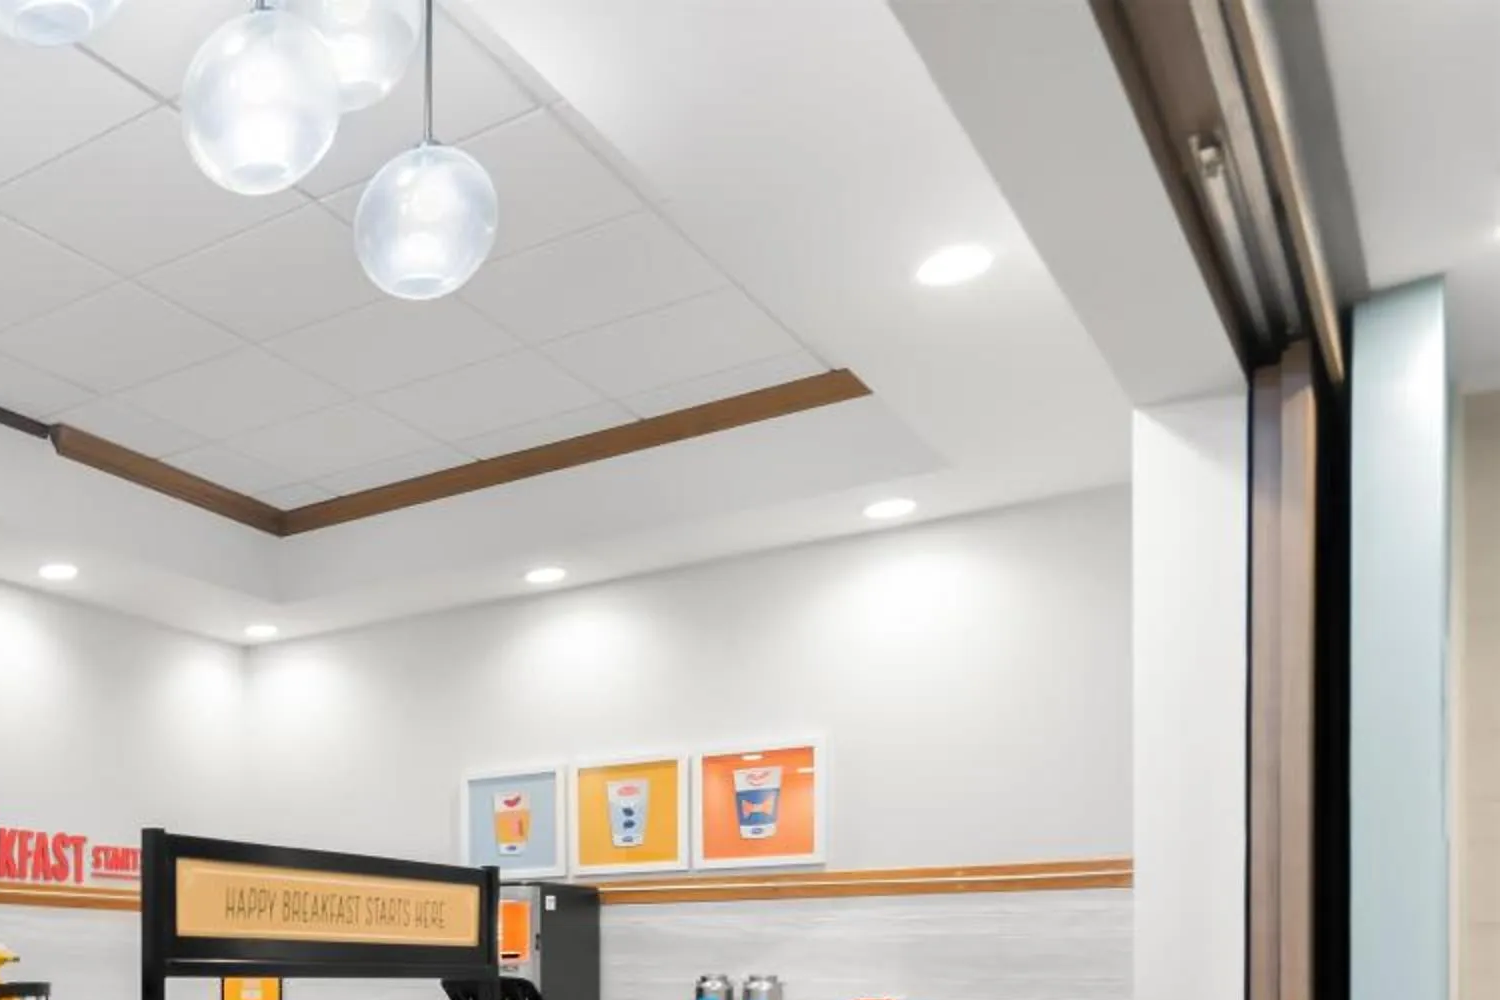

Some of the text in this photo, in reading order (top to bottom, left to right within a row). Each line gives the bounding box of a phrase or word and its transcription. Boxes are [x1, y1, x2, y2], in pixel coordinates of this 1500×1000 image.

[91, 846, 142, 871] START
[225, 886, 447, 930] HAPPY BREAKFAST STARTS HERE
